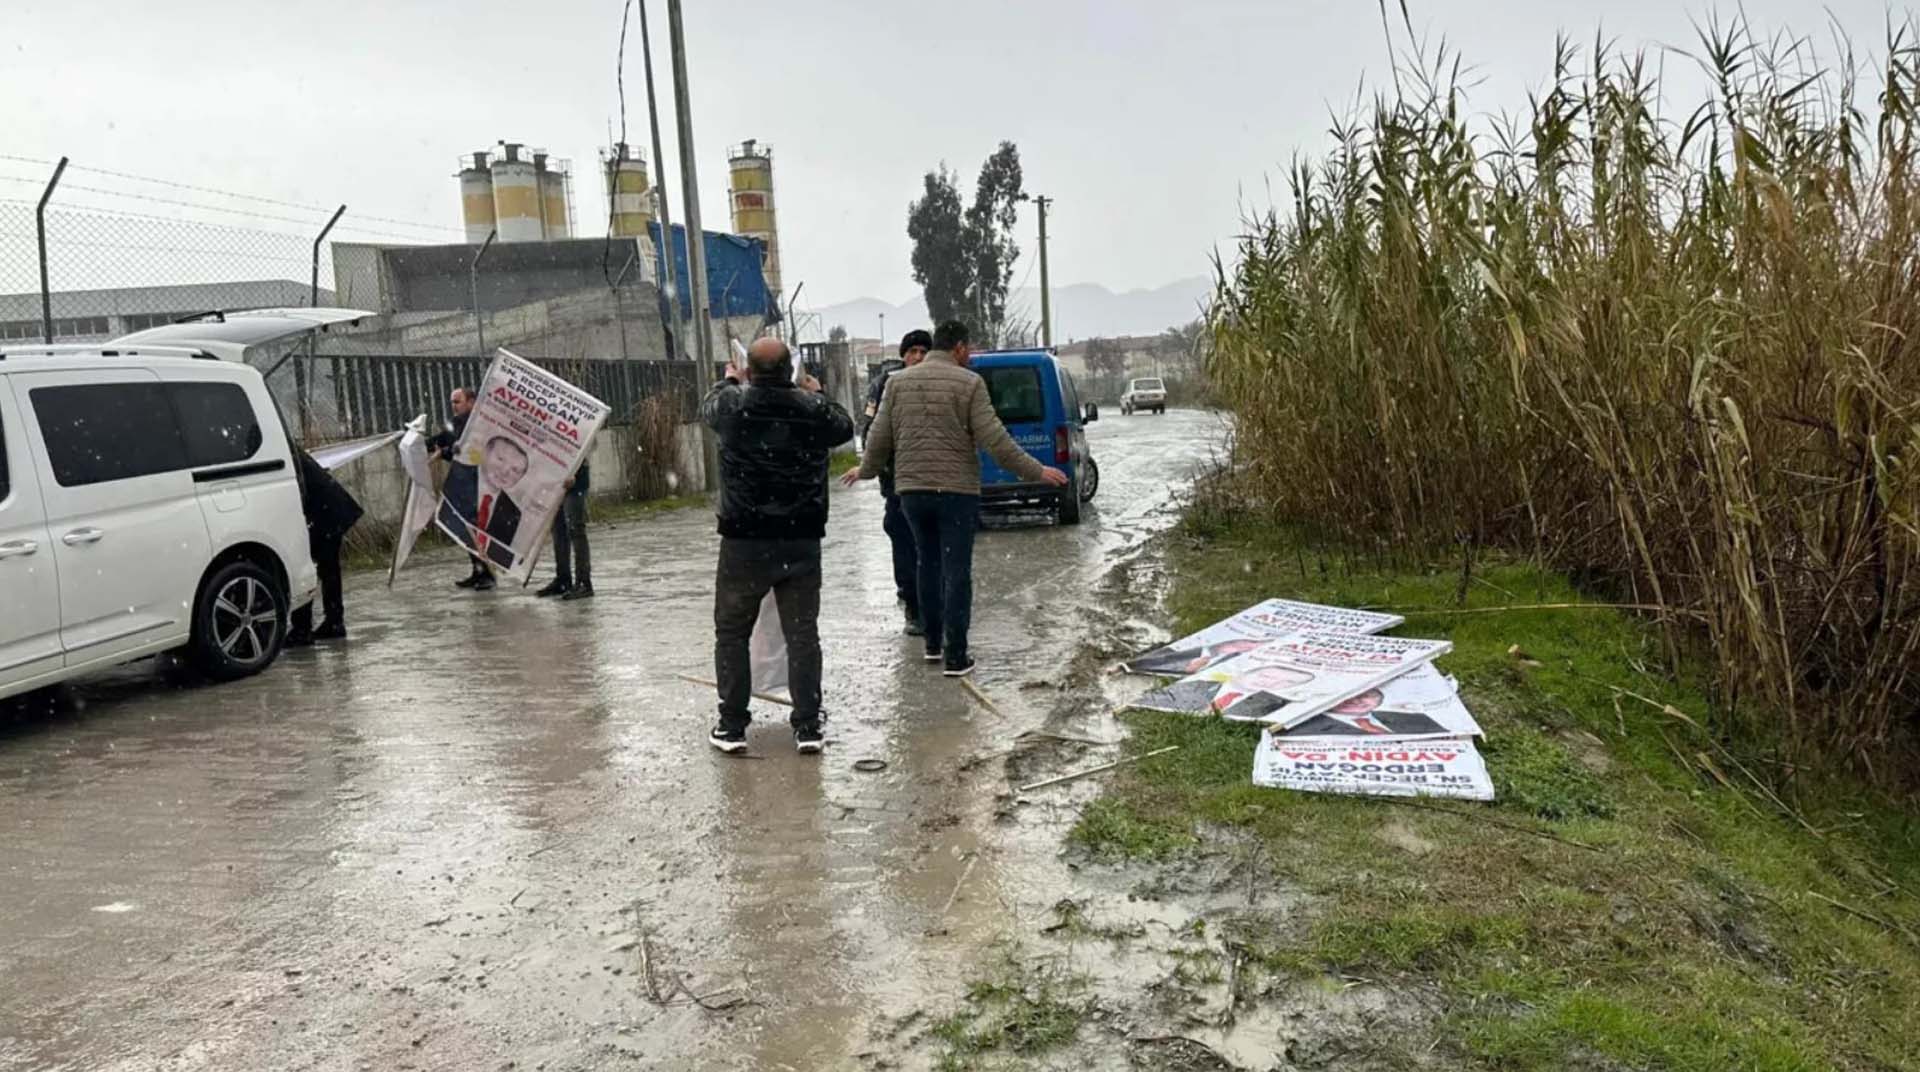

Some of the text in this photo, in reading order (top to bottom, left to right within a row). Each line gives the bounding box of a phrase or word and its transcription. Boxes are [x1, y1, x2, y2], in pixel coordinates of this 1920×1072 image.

[520, 376, 557, 400] RECEP
[555, 420, 577, 440] DA
[1281, 751, 1327, 761] DA
